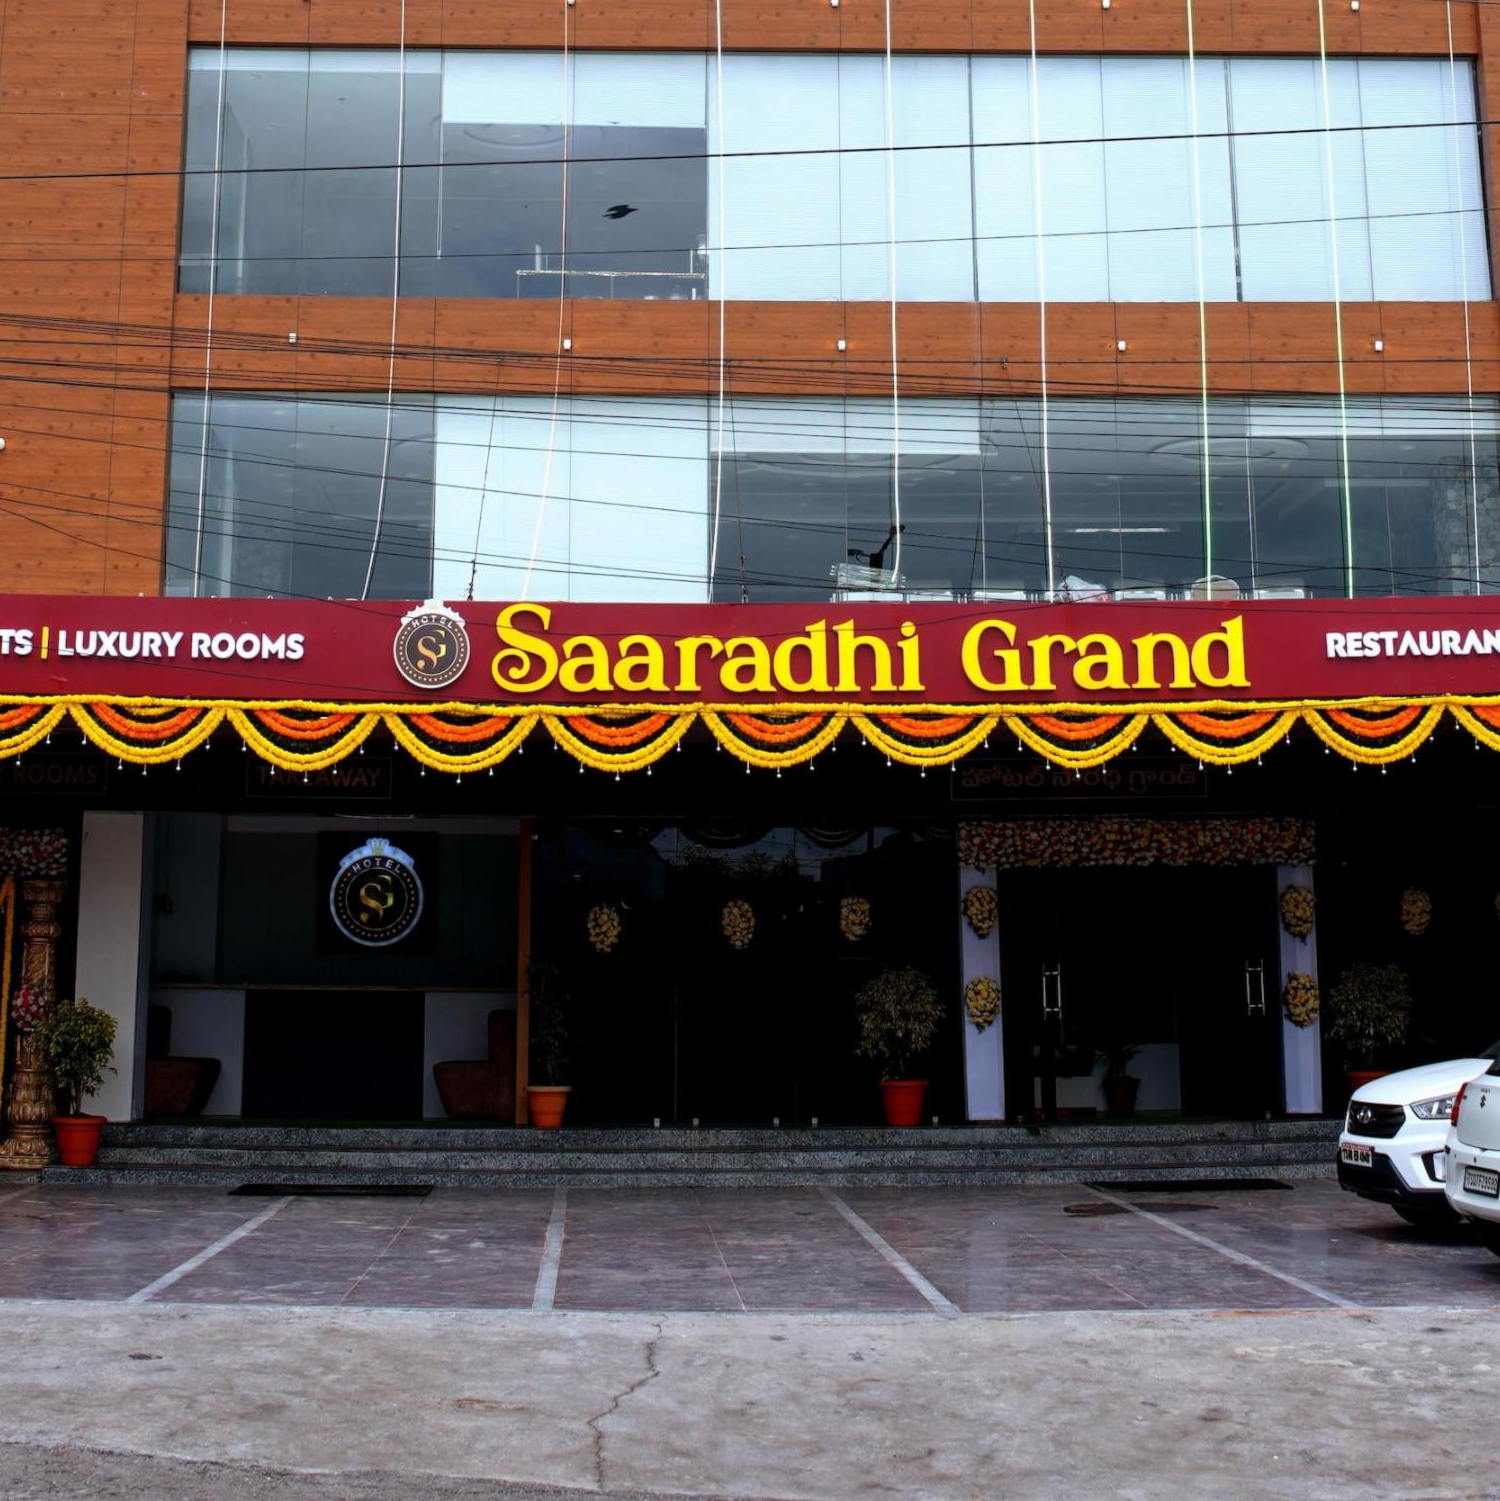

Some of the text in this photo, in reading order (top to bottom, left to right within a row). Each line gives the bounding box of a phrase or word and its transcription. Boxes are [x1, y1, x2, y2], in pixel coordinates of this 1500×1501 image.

[412, 615, 453, 629] HOTEL
[57, 630, 185, 659] LUXURY
[190, 631, 305, 661] ROOMS
[491, 602, 1251, 694] Saaradhi Grand
[352, 858, 401, 874] HOTEL
